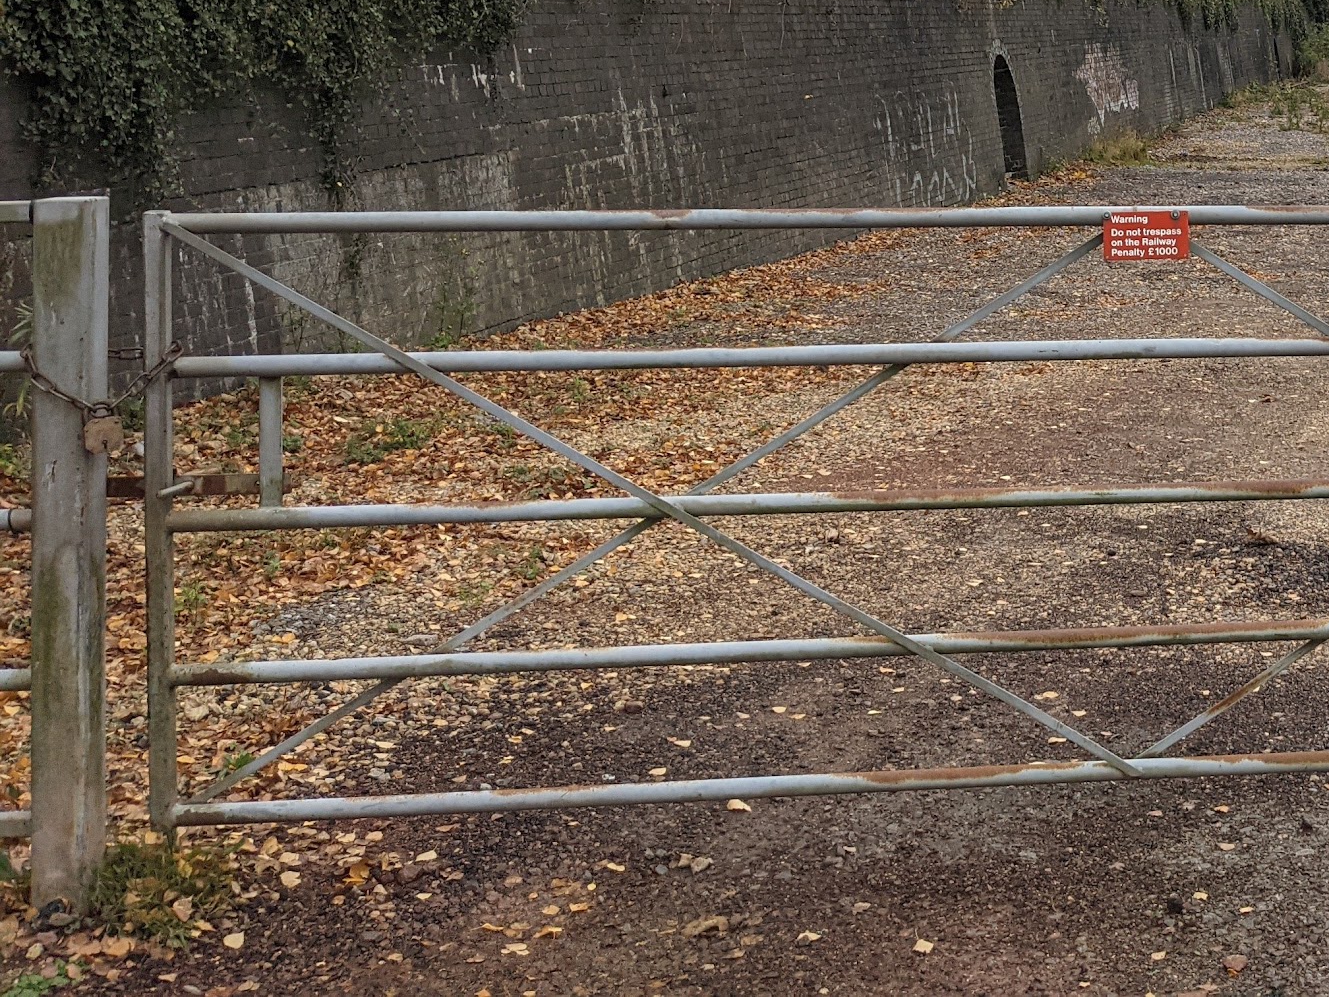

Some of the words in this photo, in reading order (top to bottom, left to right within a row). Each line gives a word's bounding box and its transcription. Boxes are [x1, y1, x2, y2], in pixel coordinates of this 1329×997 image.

[1111, 215, 1148, 224] Warning
[1111, 228, 1124, 236] Do
[1126, 228, 1141, 236] not
[1143, 228, 1182, 237] trespass
[1125, 238, 1140, 246] the
[1142, 237, 1176, 246] Railway
[1111, 248, 1145, 257] Penalty
[1148, 247, 1178, 256] £1000
